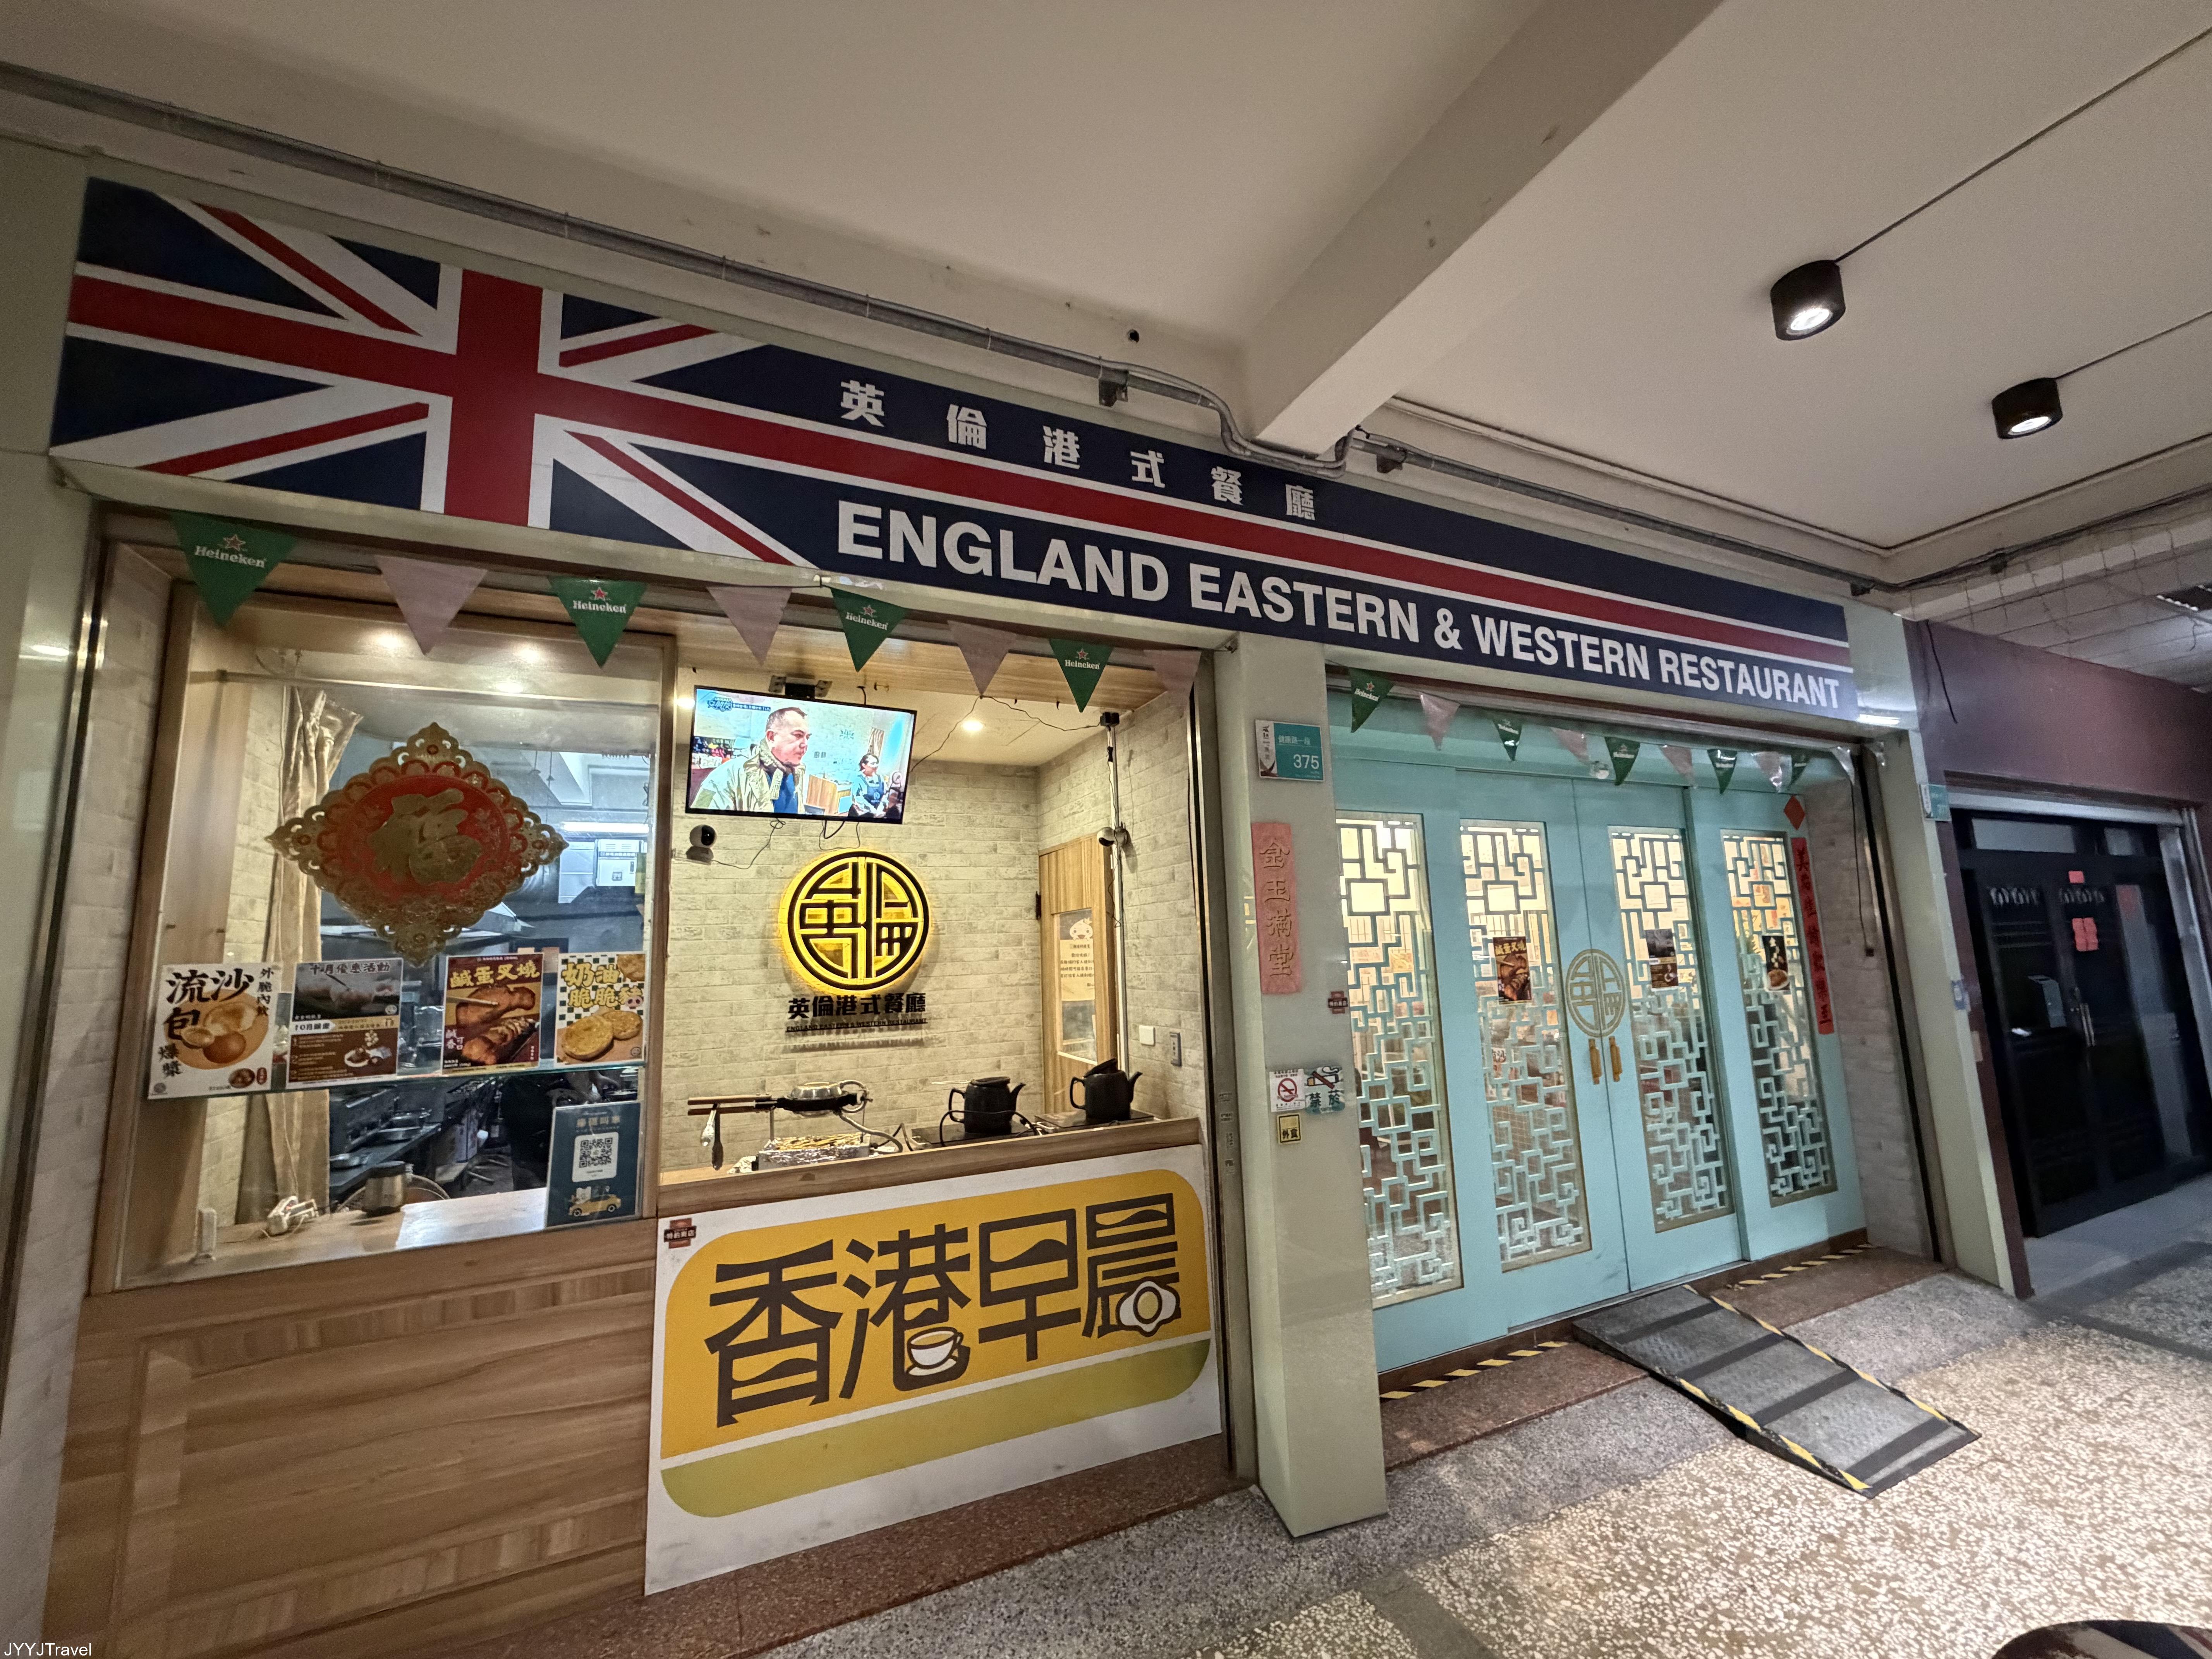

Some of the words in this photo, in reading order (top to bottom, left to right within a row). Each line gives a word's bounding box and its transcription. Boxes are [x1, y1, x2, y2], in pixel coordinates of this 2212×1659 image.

[841, 380, 1316, 520] 英倫港式餐廳
[194, 544, 266, 569] Heineken
[572, 599, 627, 615] Heineken
[838, 500, 1169, 603] ENGLAND
[1189, 562, 1419, 644] EASTERN
[1434, 607, 1463, 651] &
[1472, 613, 1650, 682] WESTERN
[1659, 648, 1840, 710] RESTAURANT
[845, 611, 889, 631] Heineken
[1064, 660, 1100, 671] Heineken
[1293, 754, 1320, 769] 375
[1259, 838, 1294, 977] 金玉滿堂
[165, 968, 254, 1004] 流沙
[449, 959, 541, 989] 鹹蛋叉燒
[561, 962, 620, 987] 奶油
[788, 993, 927, 1020] 英倫港式餐廳
[163, 1007, 203, 1049] 包
[704, 1192, 1182, 1428] 香港早晨
